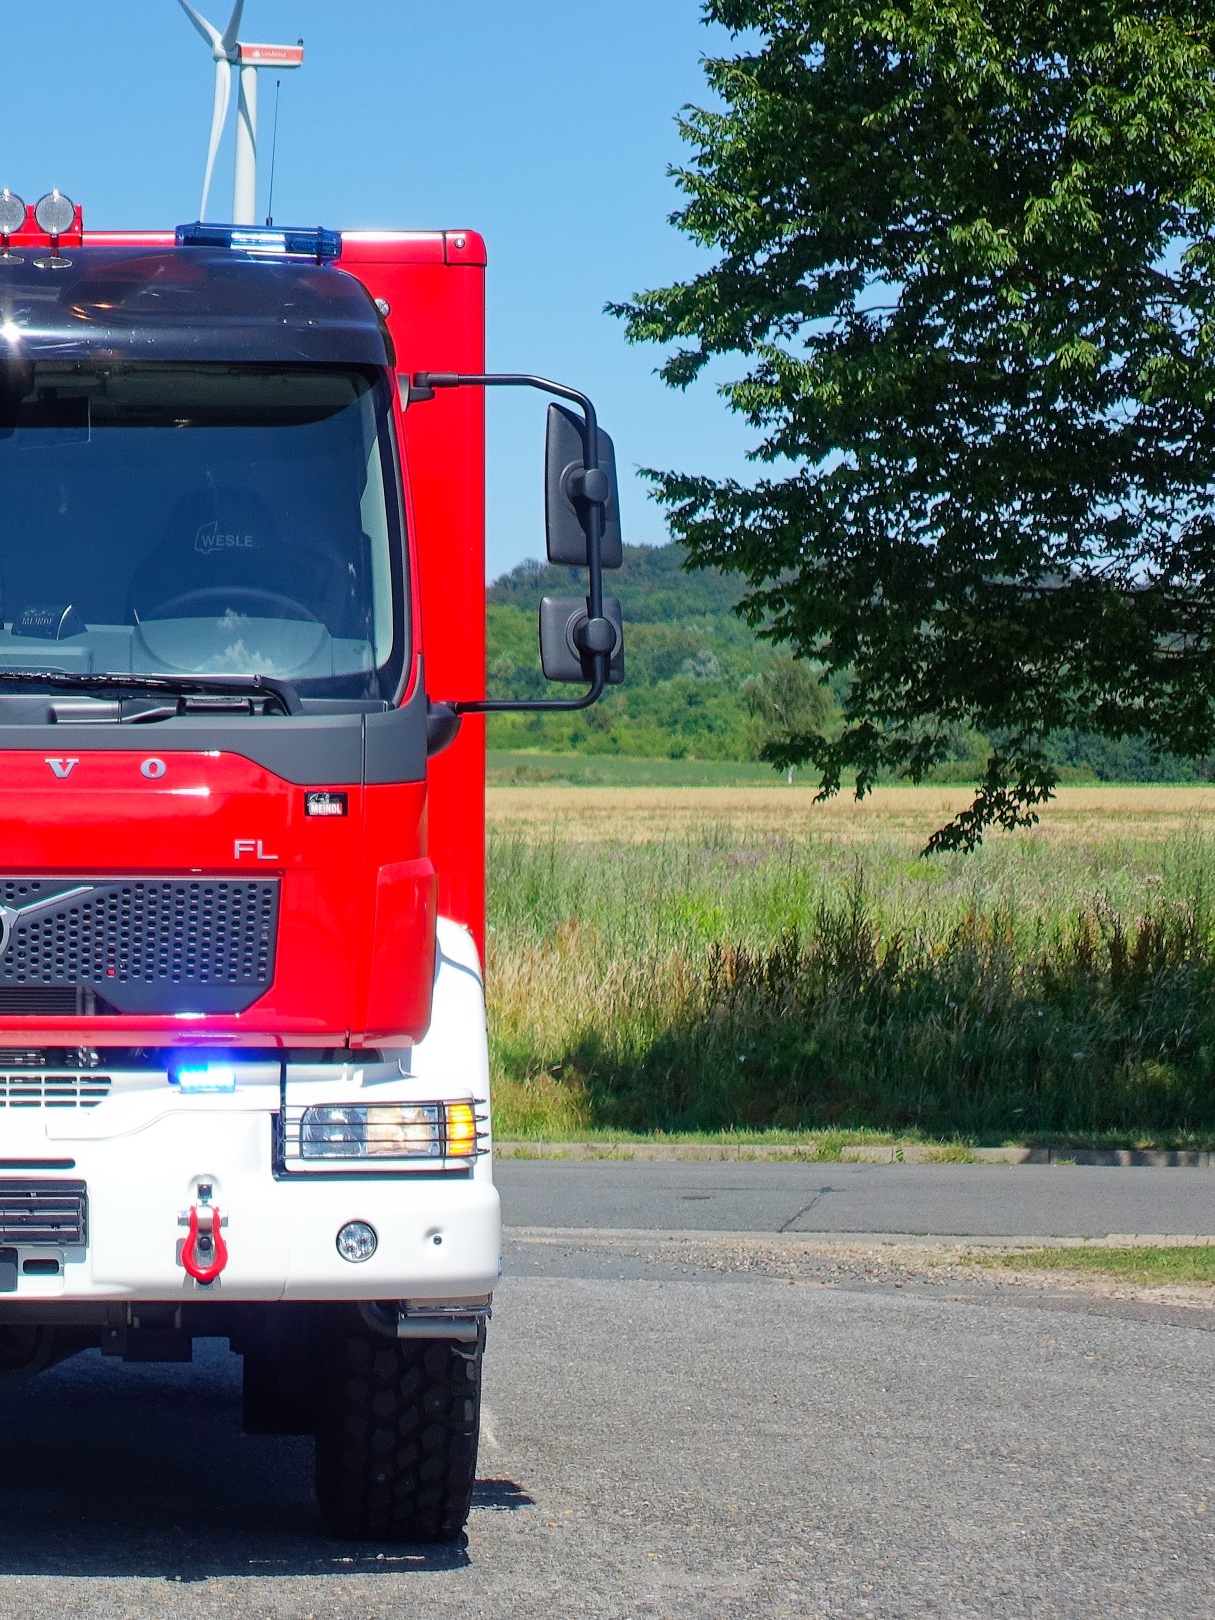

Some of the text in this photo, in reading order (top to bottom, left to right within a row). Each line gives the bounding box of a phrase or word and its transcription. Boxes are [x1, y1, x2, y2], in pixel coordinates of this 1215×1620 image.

[202, 535, 253, 547] WESLE
[310, 802, 343, 815] MEINDL
[234, 839, 279, 860] FL
